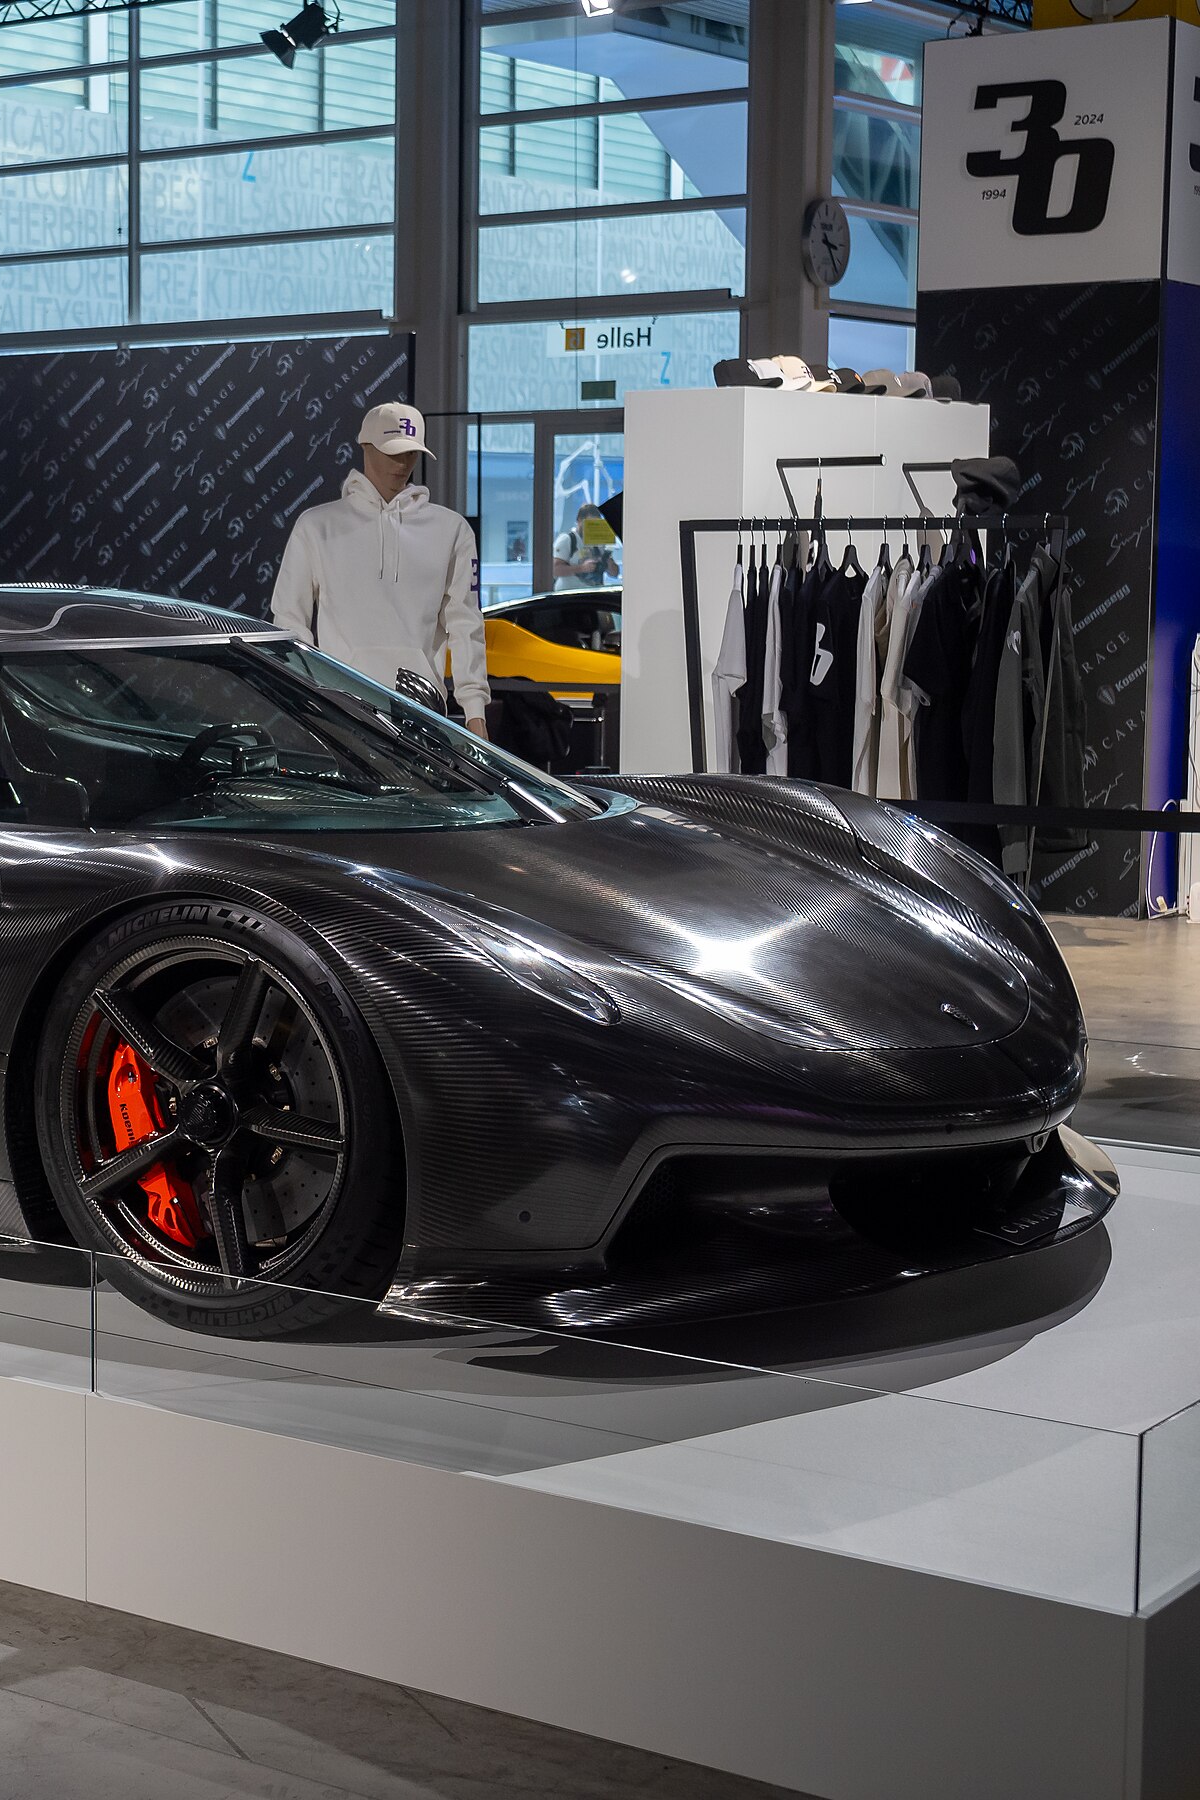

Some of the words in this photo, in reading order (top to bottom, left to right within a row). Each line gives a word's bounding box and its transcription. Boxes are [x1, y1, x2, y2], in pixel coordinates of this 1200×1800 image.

[1074, 113, 1105, 126] 2024
[981, 189, 1007, 201] 1994
[325, 346, 377, 400] CARAGE
[188, 380, 237, 433] CARAGE
[216, 423, 266, 476] CARAGE
[1081, 630, 1131, 675] RAGE
[108, 905, 211, 949] MICHELIN
